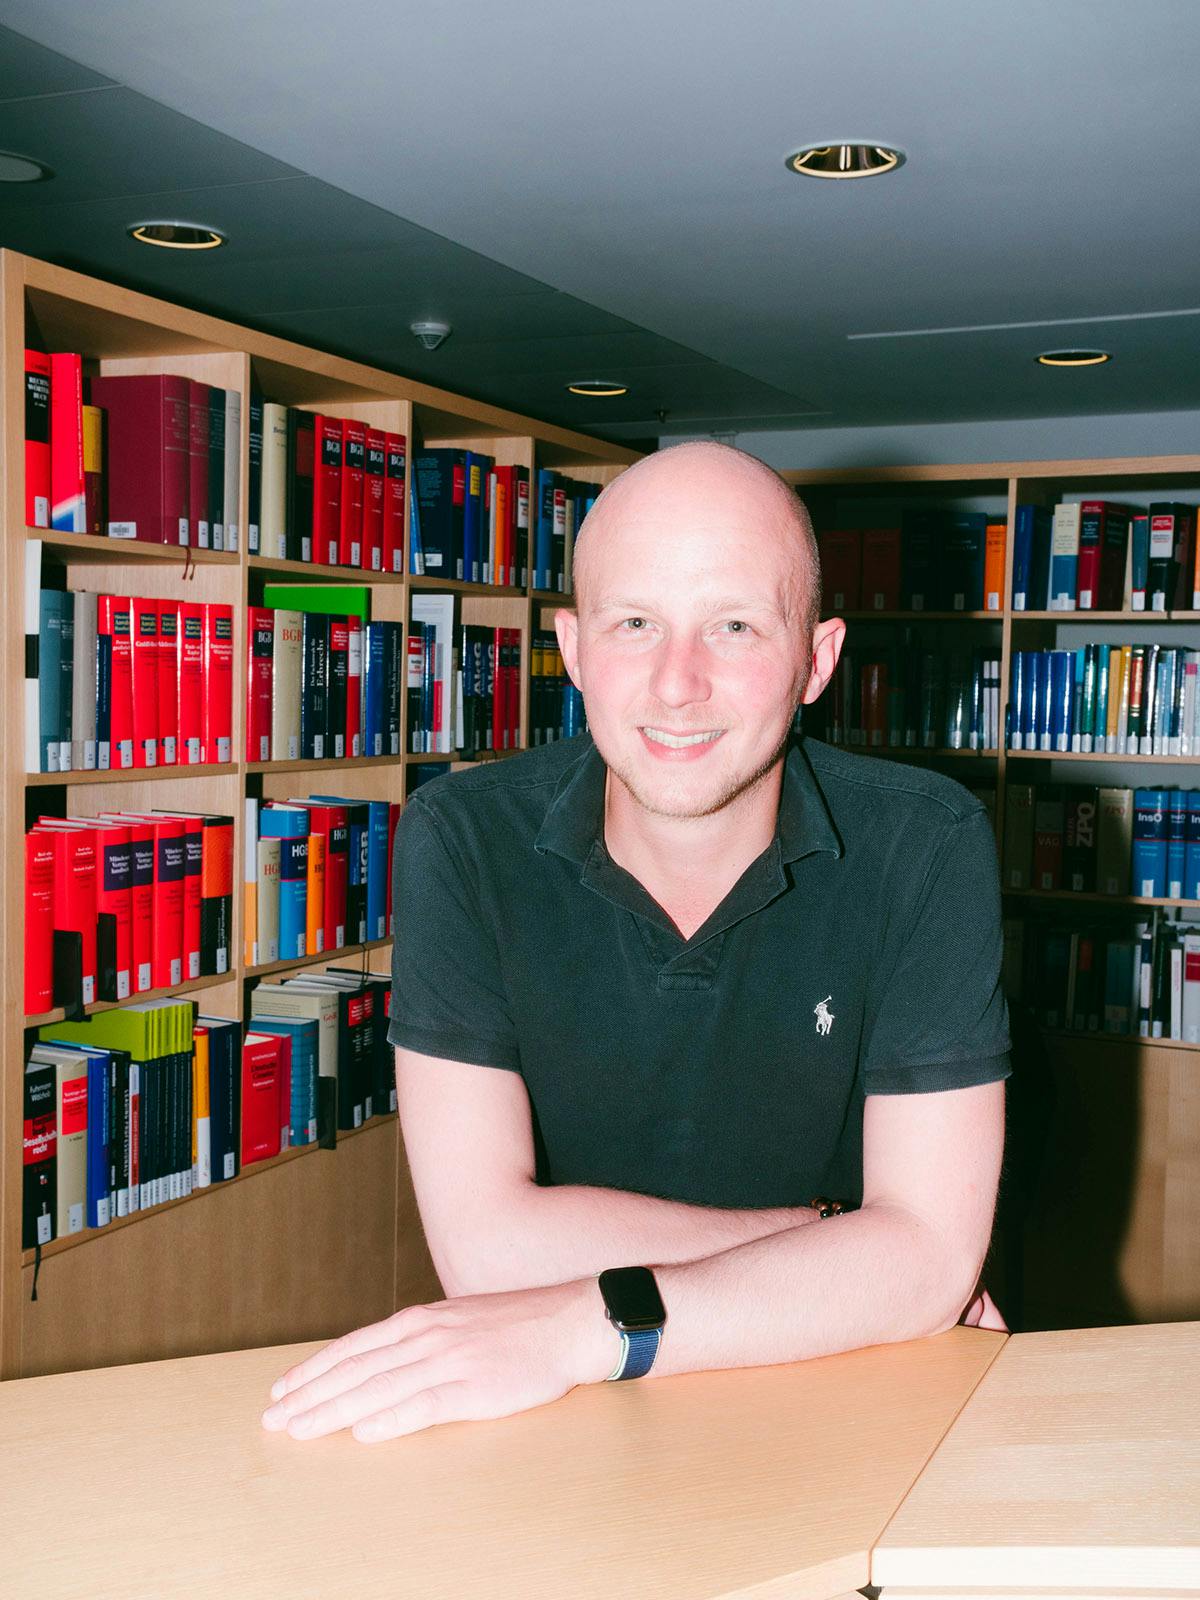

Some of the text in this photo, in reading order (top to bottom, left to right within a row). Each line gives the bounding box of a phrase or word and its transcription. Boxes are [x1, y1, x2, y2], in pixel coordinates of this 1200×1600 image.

[326, 440, 340, 453] BGB
[350, 443, 364, 455] BGB
[370, 451, 384, 462] BGB
[391, 455, 405, 467] BGB
[258, 631, 272, 643] BGB
[282, 629, 302, 641] BGB
[316, 639, 324, 686] Erbrecht
[1138, 812, 1162, 823] InsO
[1076, 802, 1096, 847] ZPO
[33, 1143, 48, 1154] recht
